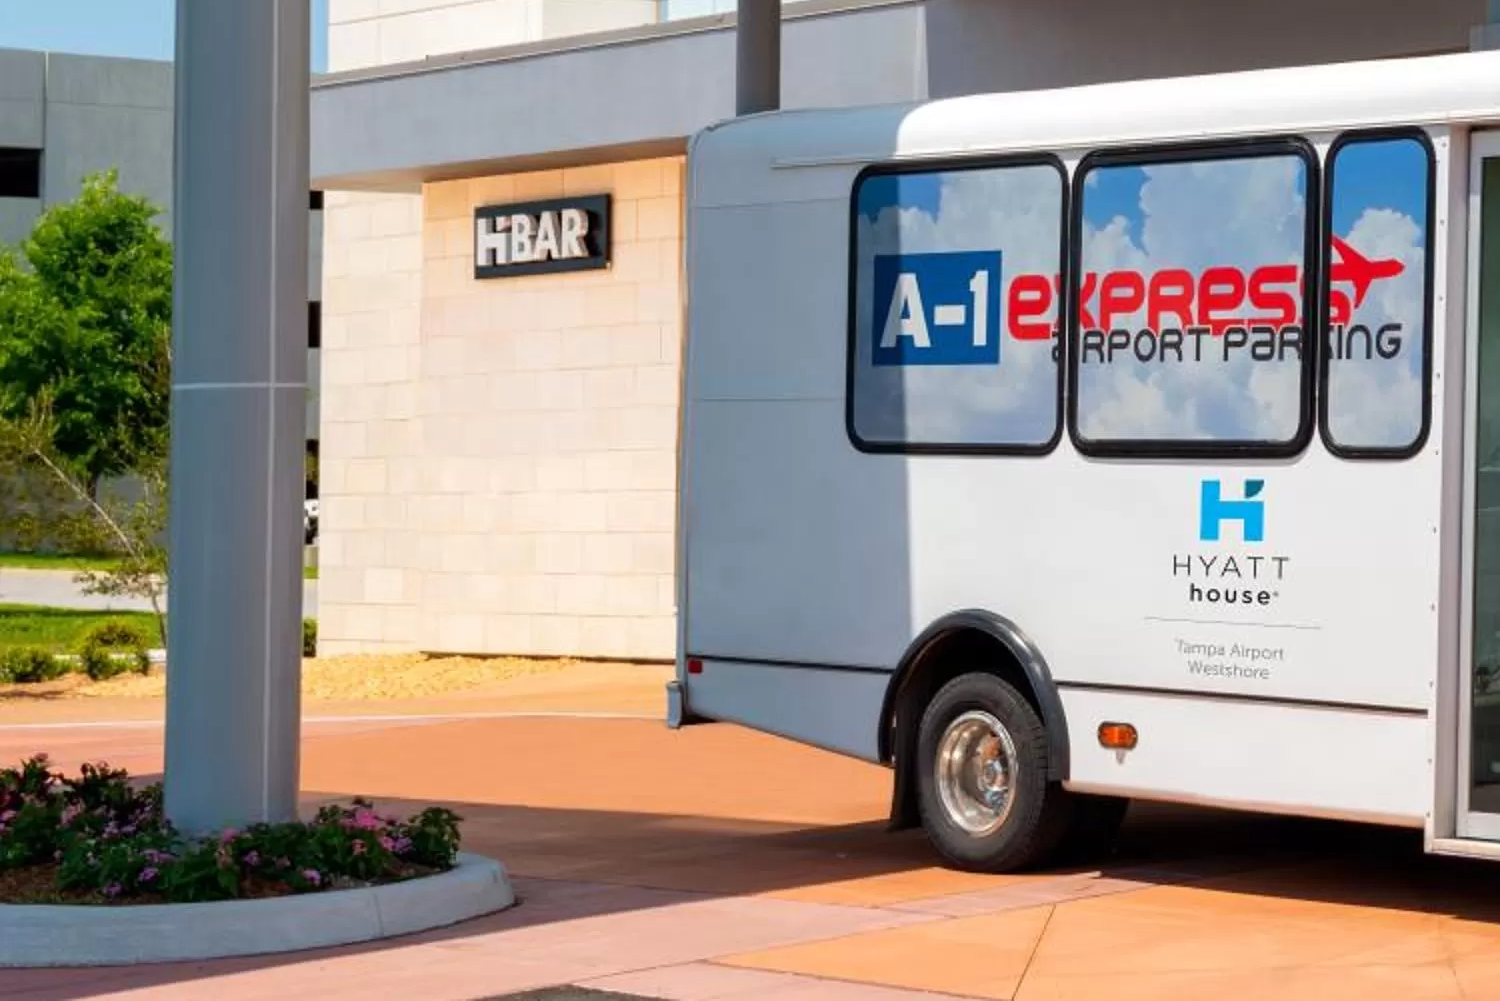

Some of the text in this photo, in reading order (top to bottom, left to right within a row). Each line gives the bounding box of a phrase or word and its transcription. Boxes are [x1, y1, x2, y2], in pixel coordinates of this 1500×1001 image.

[879, 269, 990, 348] A-1
[1172, 554, 1290, 580] HYATT
[1188, 583, 1271, 606] house
[1174, 637, 1284, 661] Tampa Airport
[1187, 660, 1270, 680] Westshore
